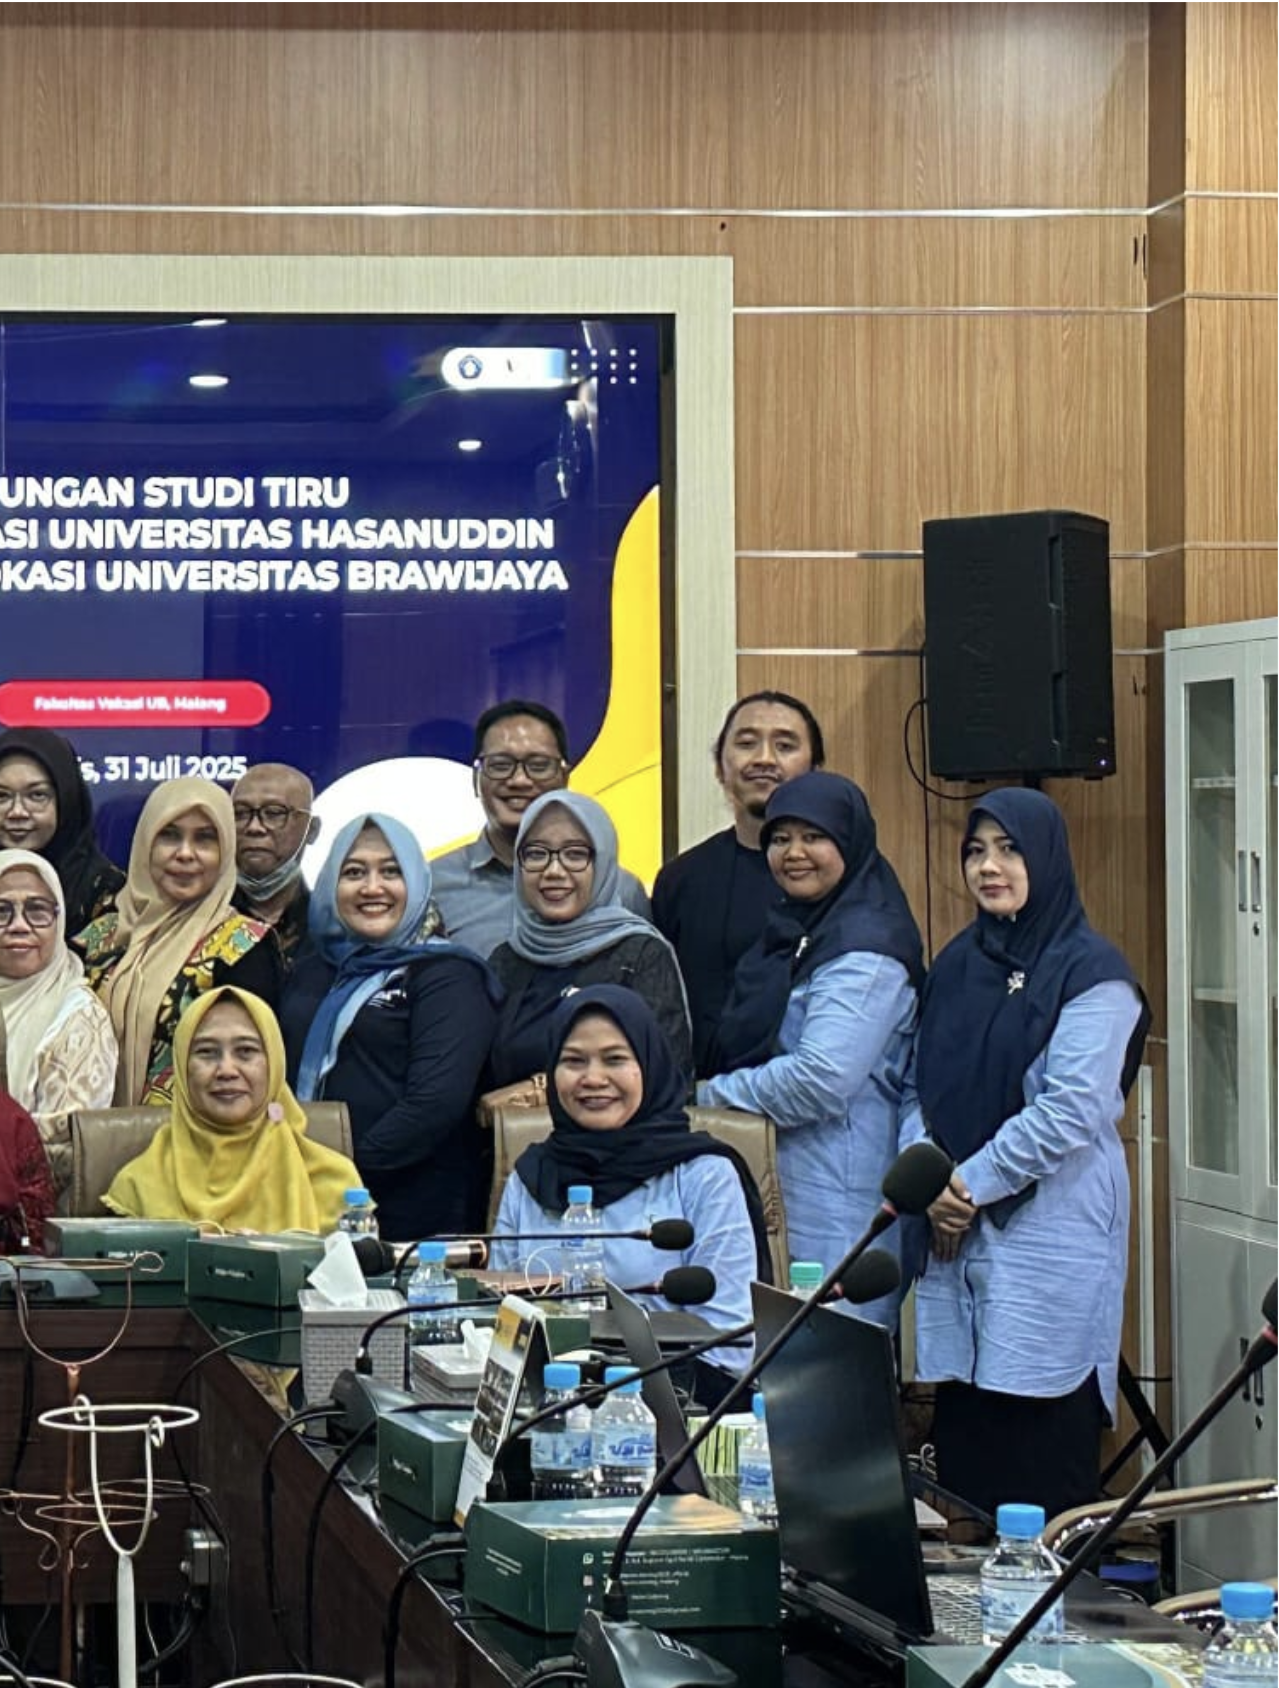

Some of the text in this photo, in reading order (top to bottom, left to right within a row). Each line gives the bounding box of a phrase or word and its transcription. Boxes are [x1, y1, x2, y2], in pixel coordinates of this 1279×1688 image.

[143, 476, 254, 509] STUDI
[261, 476, 350, 509] TIRU
[48, 518, 293, 550] UNIVERSITAS
[301, 517, 554, 550] HASANUDDIN
[95, 560, 341, 592] UNIVERSITAS
[347, 560, 569, 592] BRAWIJAYA
[34, 696, 96, 711] Fakultas
[97, 696, 144, 711] Vokasi
[173, 696, 227, 713] Malang
[104, 756, 130, 781] 31
[134, 755, 181, 781] Juli
[185, 756, 248, 781] 2025
